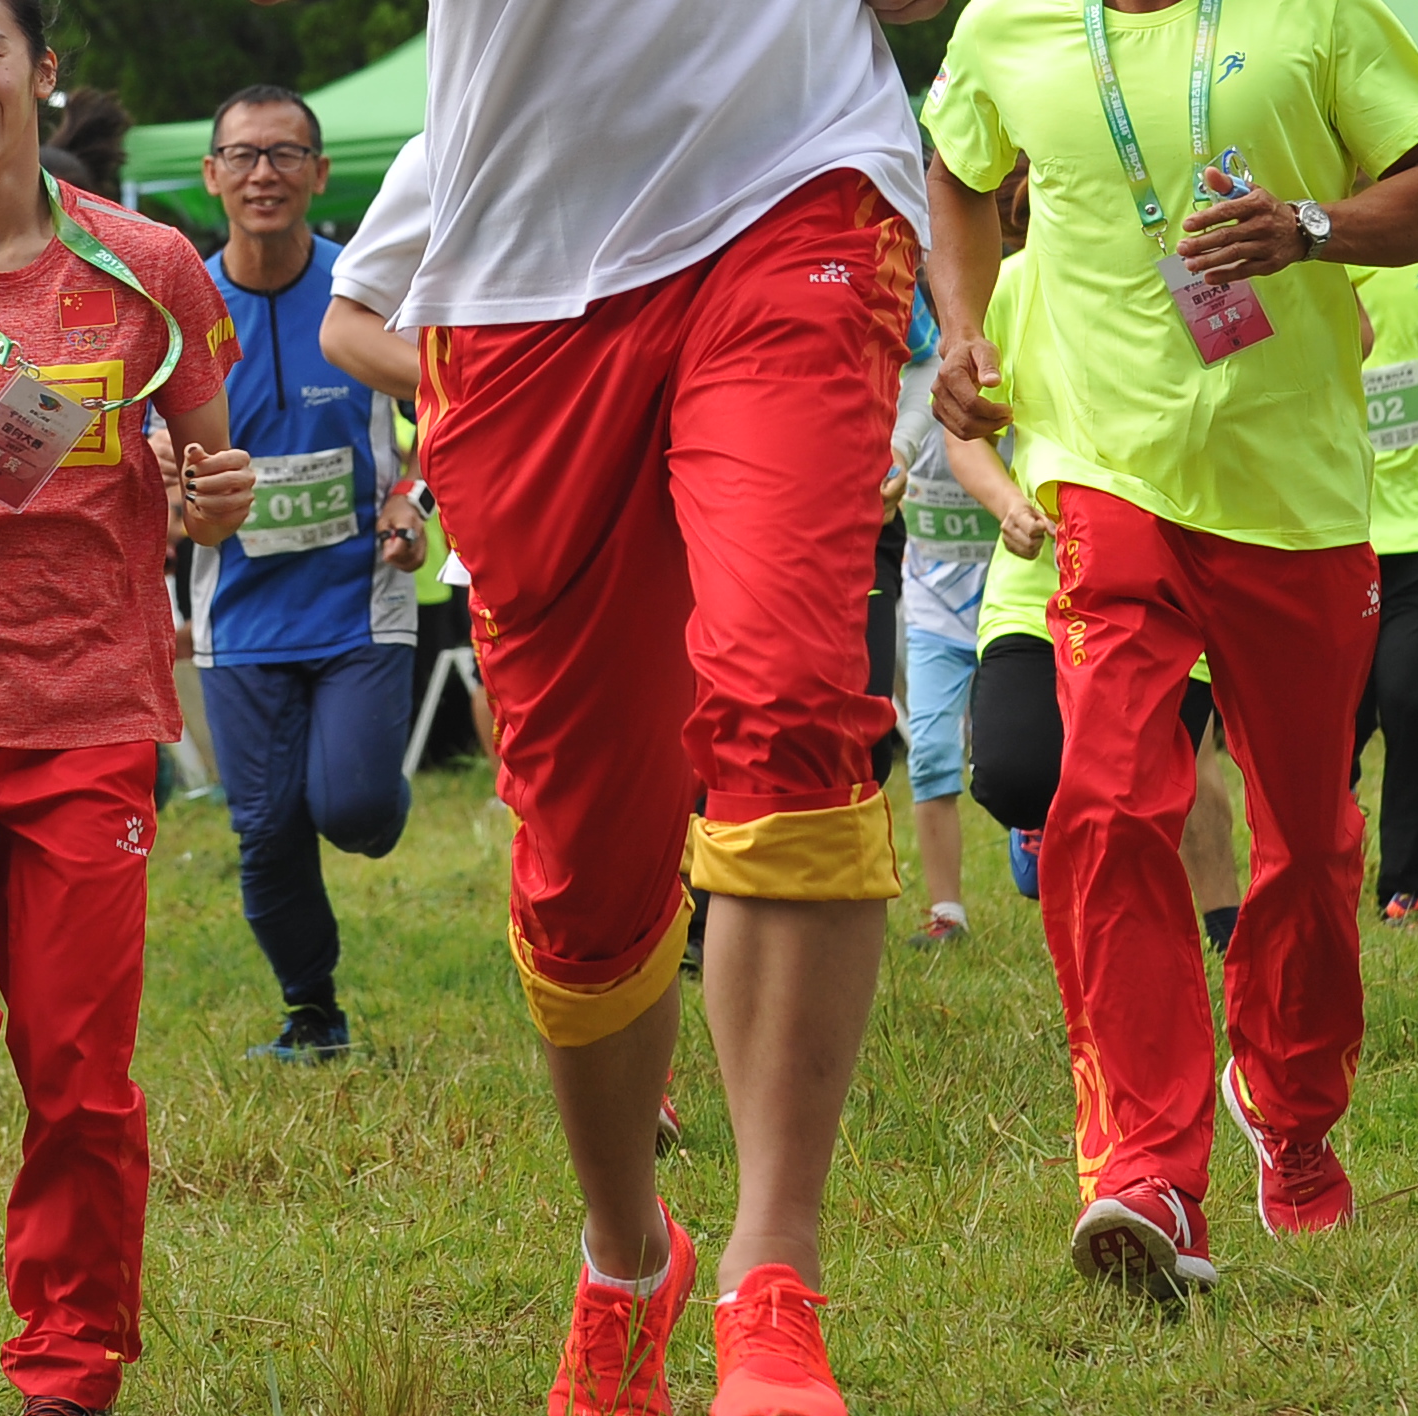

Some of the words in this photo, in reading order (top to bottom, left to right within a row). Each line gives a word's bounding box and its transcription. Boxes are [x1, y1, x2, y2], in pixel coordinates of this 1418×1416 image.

[809, 273, 851, 287] KEL
[1206, 305, 1241, 331] 嘉宾
[1367, 396, 1405, 425] 02
[918, 509, 936, 536] E
[1361, 602, 1381, 619] KEL
